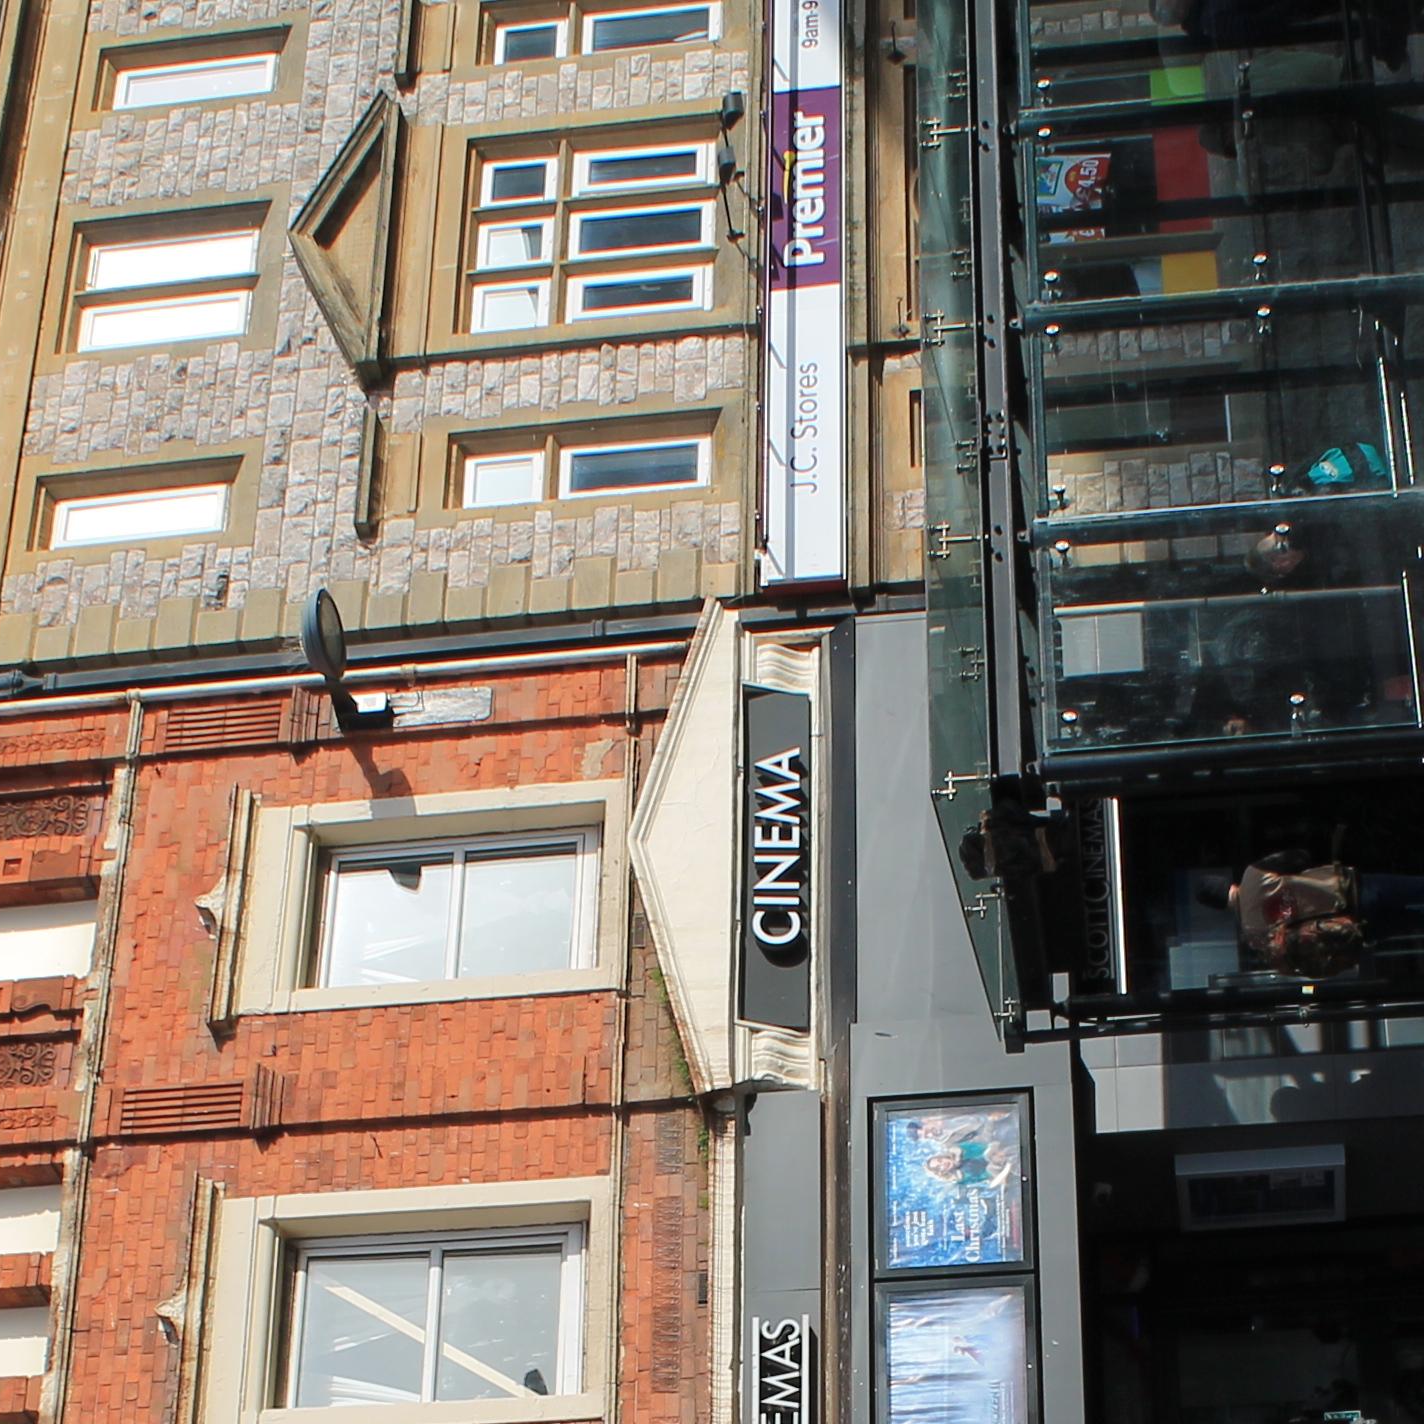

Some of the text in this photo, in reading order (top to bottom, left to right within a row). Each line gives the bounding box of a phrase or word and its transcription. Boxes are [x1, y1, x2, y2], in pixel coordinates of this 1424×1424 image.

[782, 110, 826, 266] Premier
[791, 362, 818, 495] J.C. Stores
[751, 746, 802, 946] CINEMA
[950, 1210, 965, 1242] Last
[965, 1188, 981, 1263] Christmas
